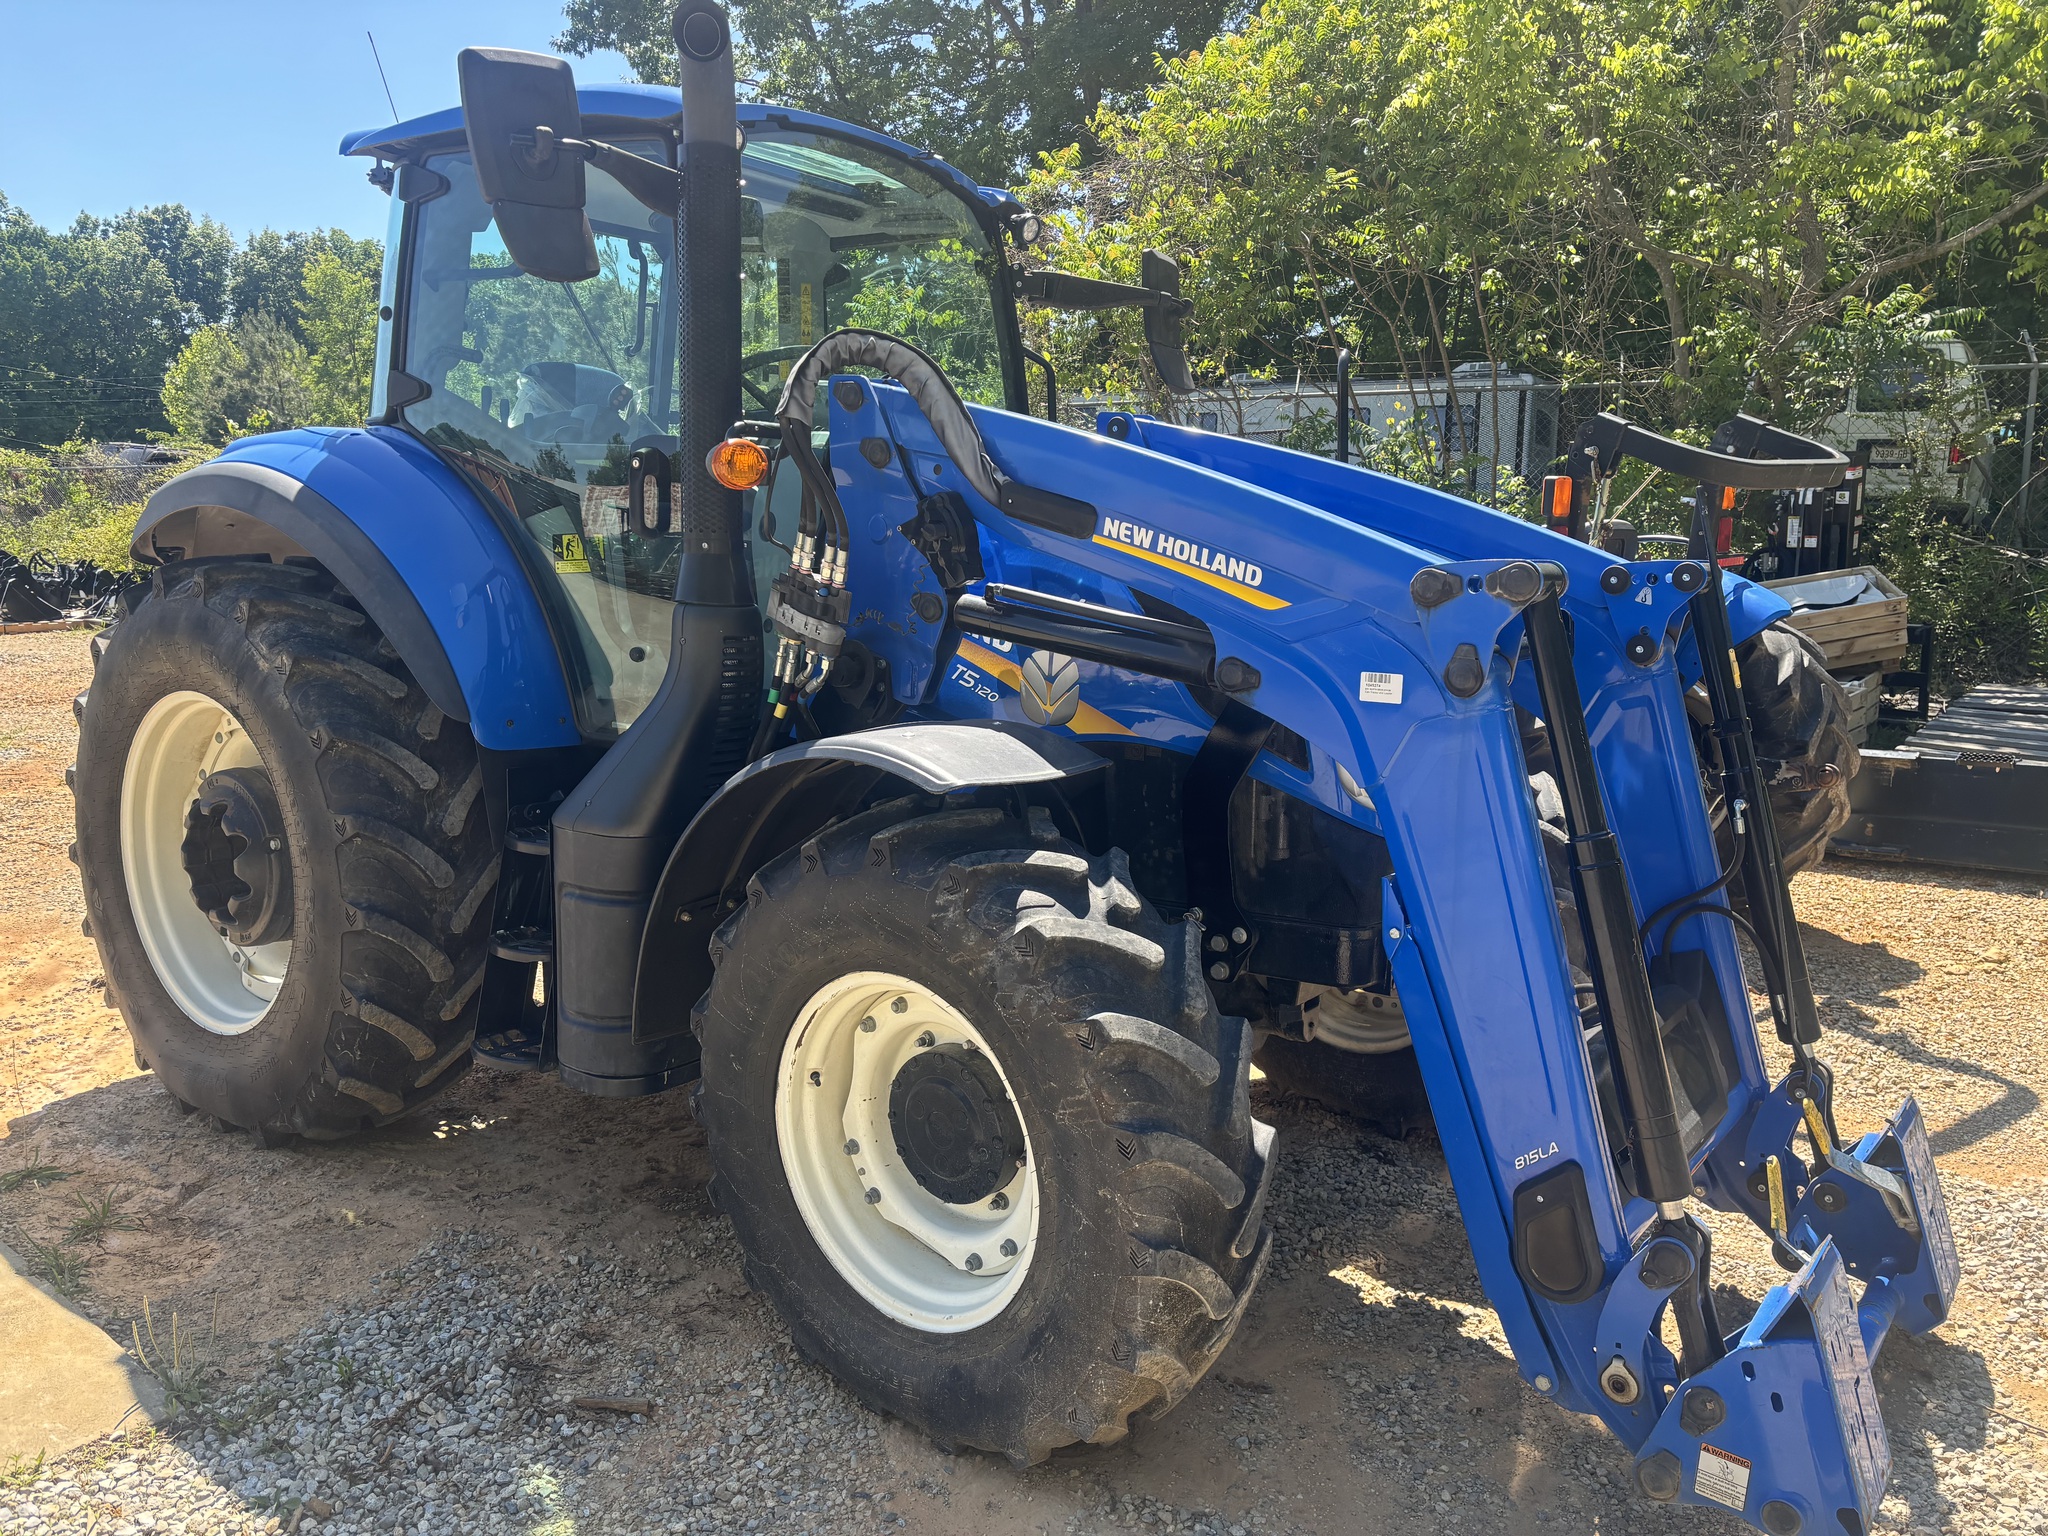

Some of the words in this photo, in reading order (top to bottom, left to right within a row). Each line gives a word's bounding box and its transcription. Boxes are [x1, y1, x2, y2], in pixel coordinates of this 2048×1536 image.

[1102, 516, 1154, 549] NEW
[1156, 533, 1263, 587] HOLLAND
[951, 663, 999, 702] T5.120
[1514, 1141, 1559, 1170] 815LA
[1711, 1448, 1750, 1468] WARNING
